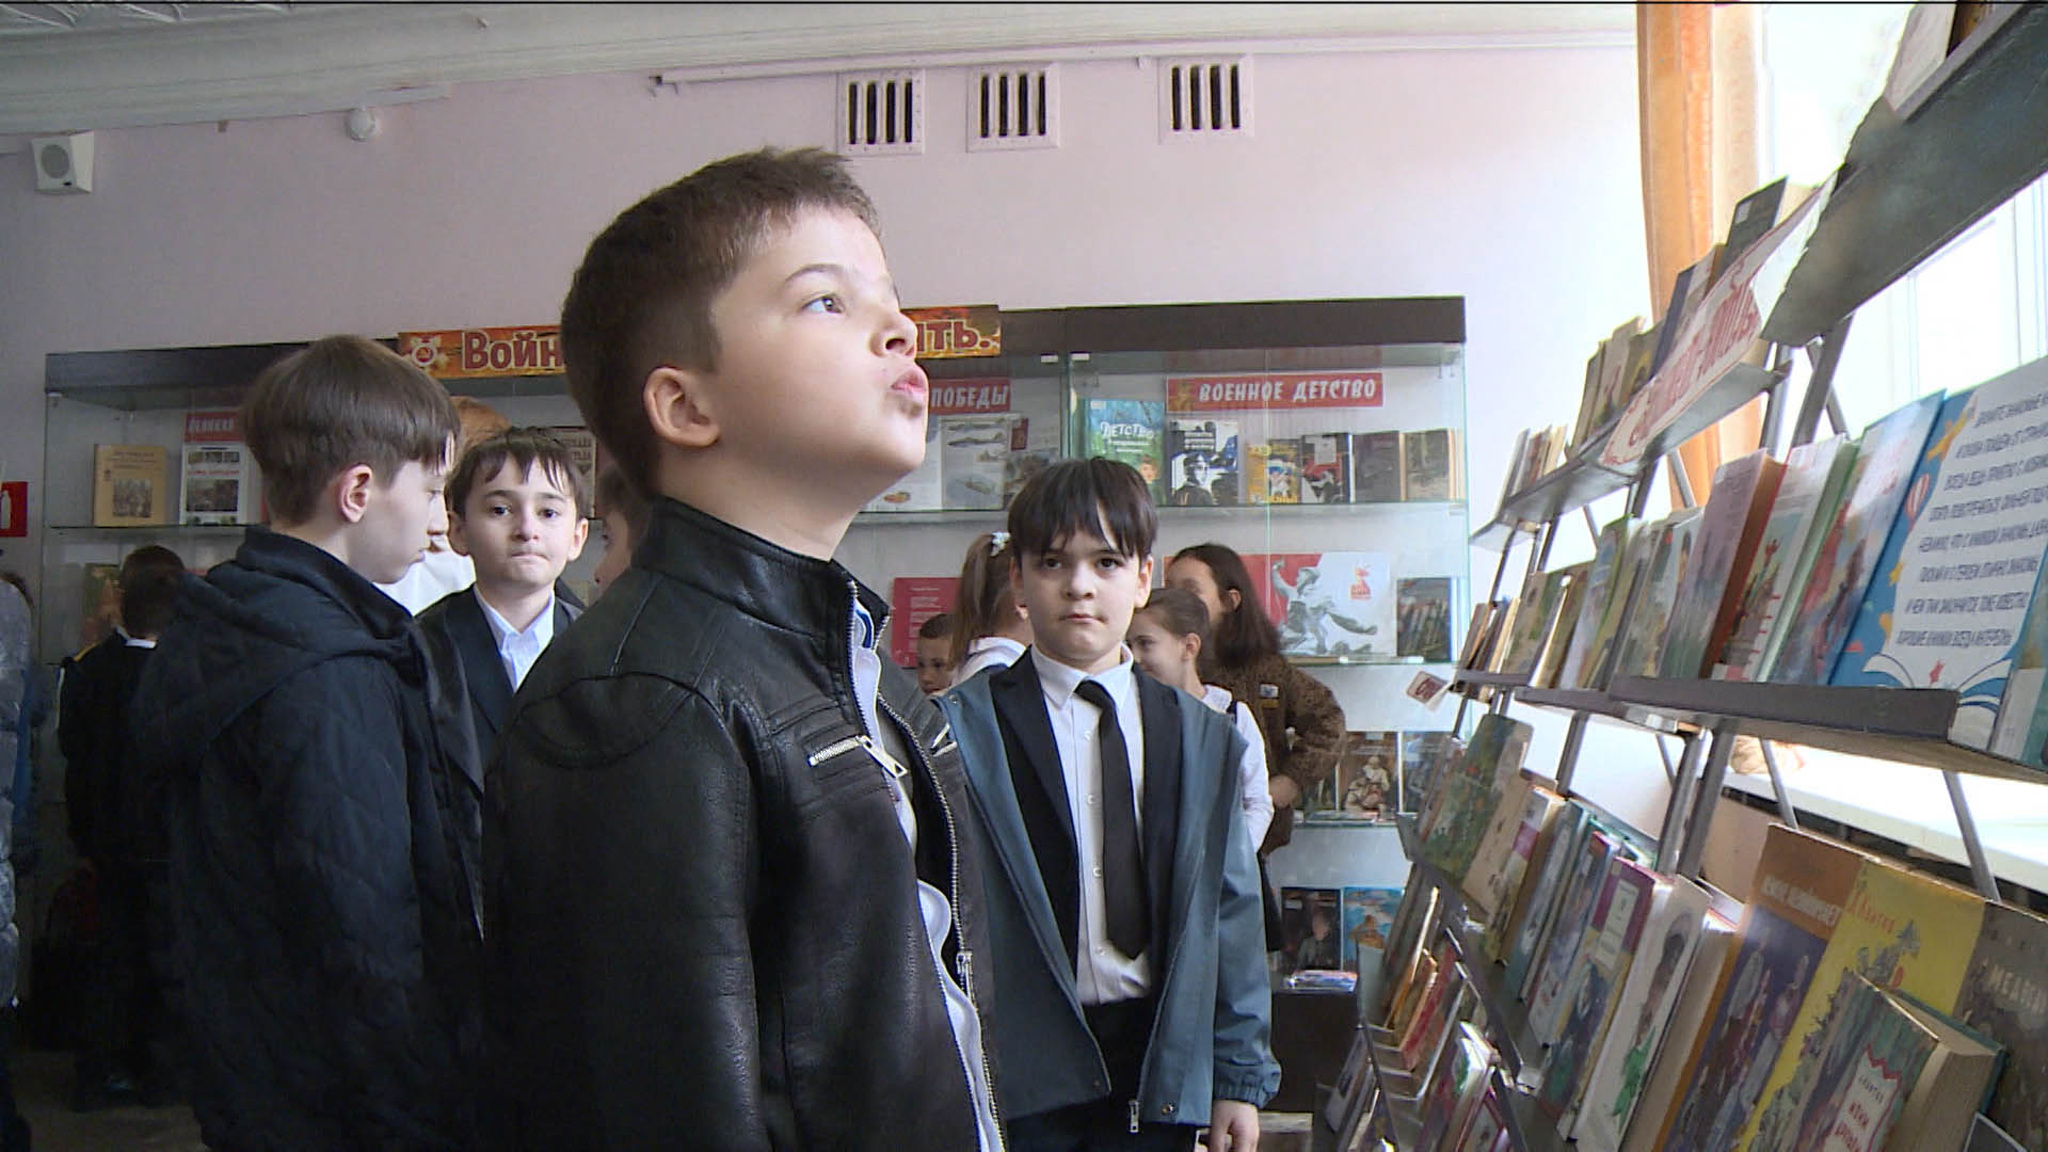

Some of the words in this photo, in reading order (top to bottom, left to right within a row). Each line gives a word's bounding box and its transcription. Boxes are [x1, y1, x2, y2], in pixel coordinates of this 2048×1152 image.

[931, 384, 1009, 408] ПОБЕДЫ
[1200, 380, 1284, 402] ВОЕННОЕ
[1293, 378, 1376, 403] ДЕТСТВО
